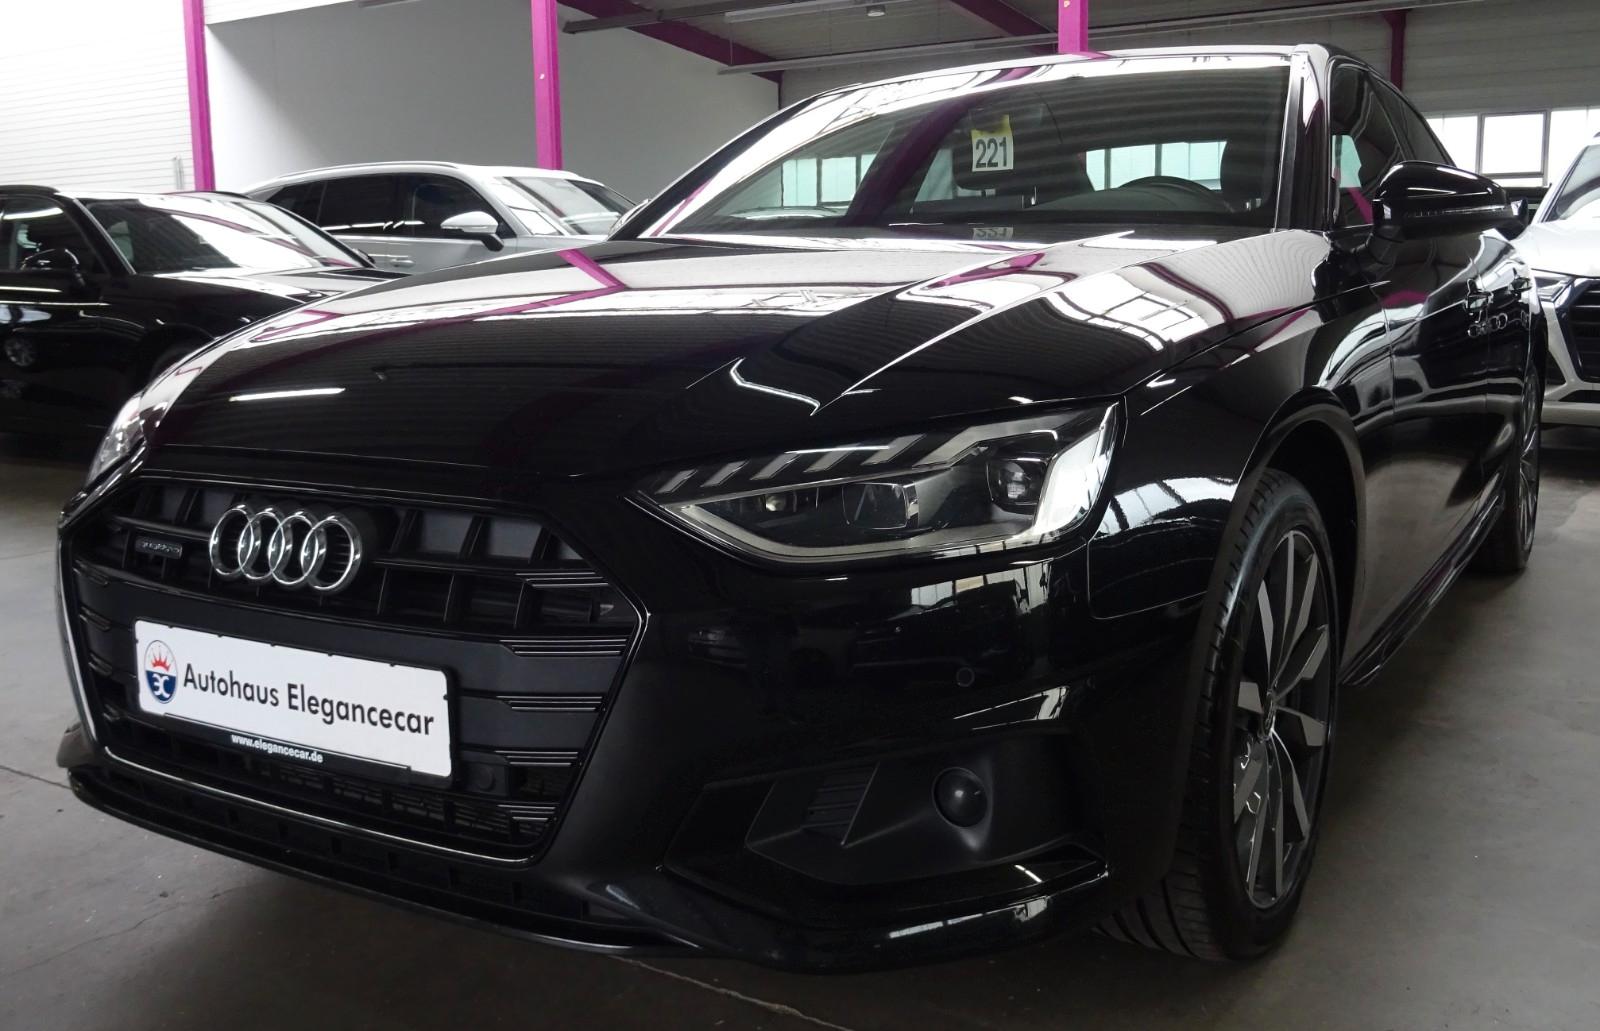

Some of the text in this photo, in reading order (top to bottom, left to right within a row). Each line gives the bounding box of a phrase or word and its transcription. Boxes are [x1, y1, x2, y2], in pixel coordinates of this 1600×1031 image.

[975, 136, 1008, 168] 221
[183, 662, 434, 736] Autohaus Elegancecar
[231, 734, 323, 763] www.elegancecar.de
